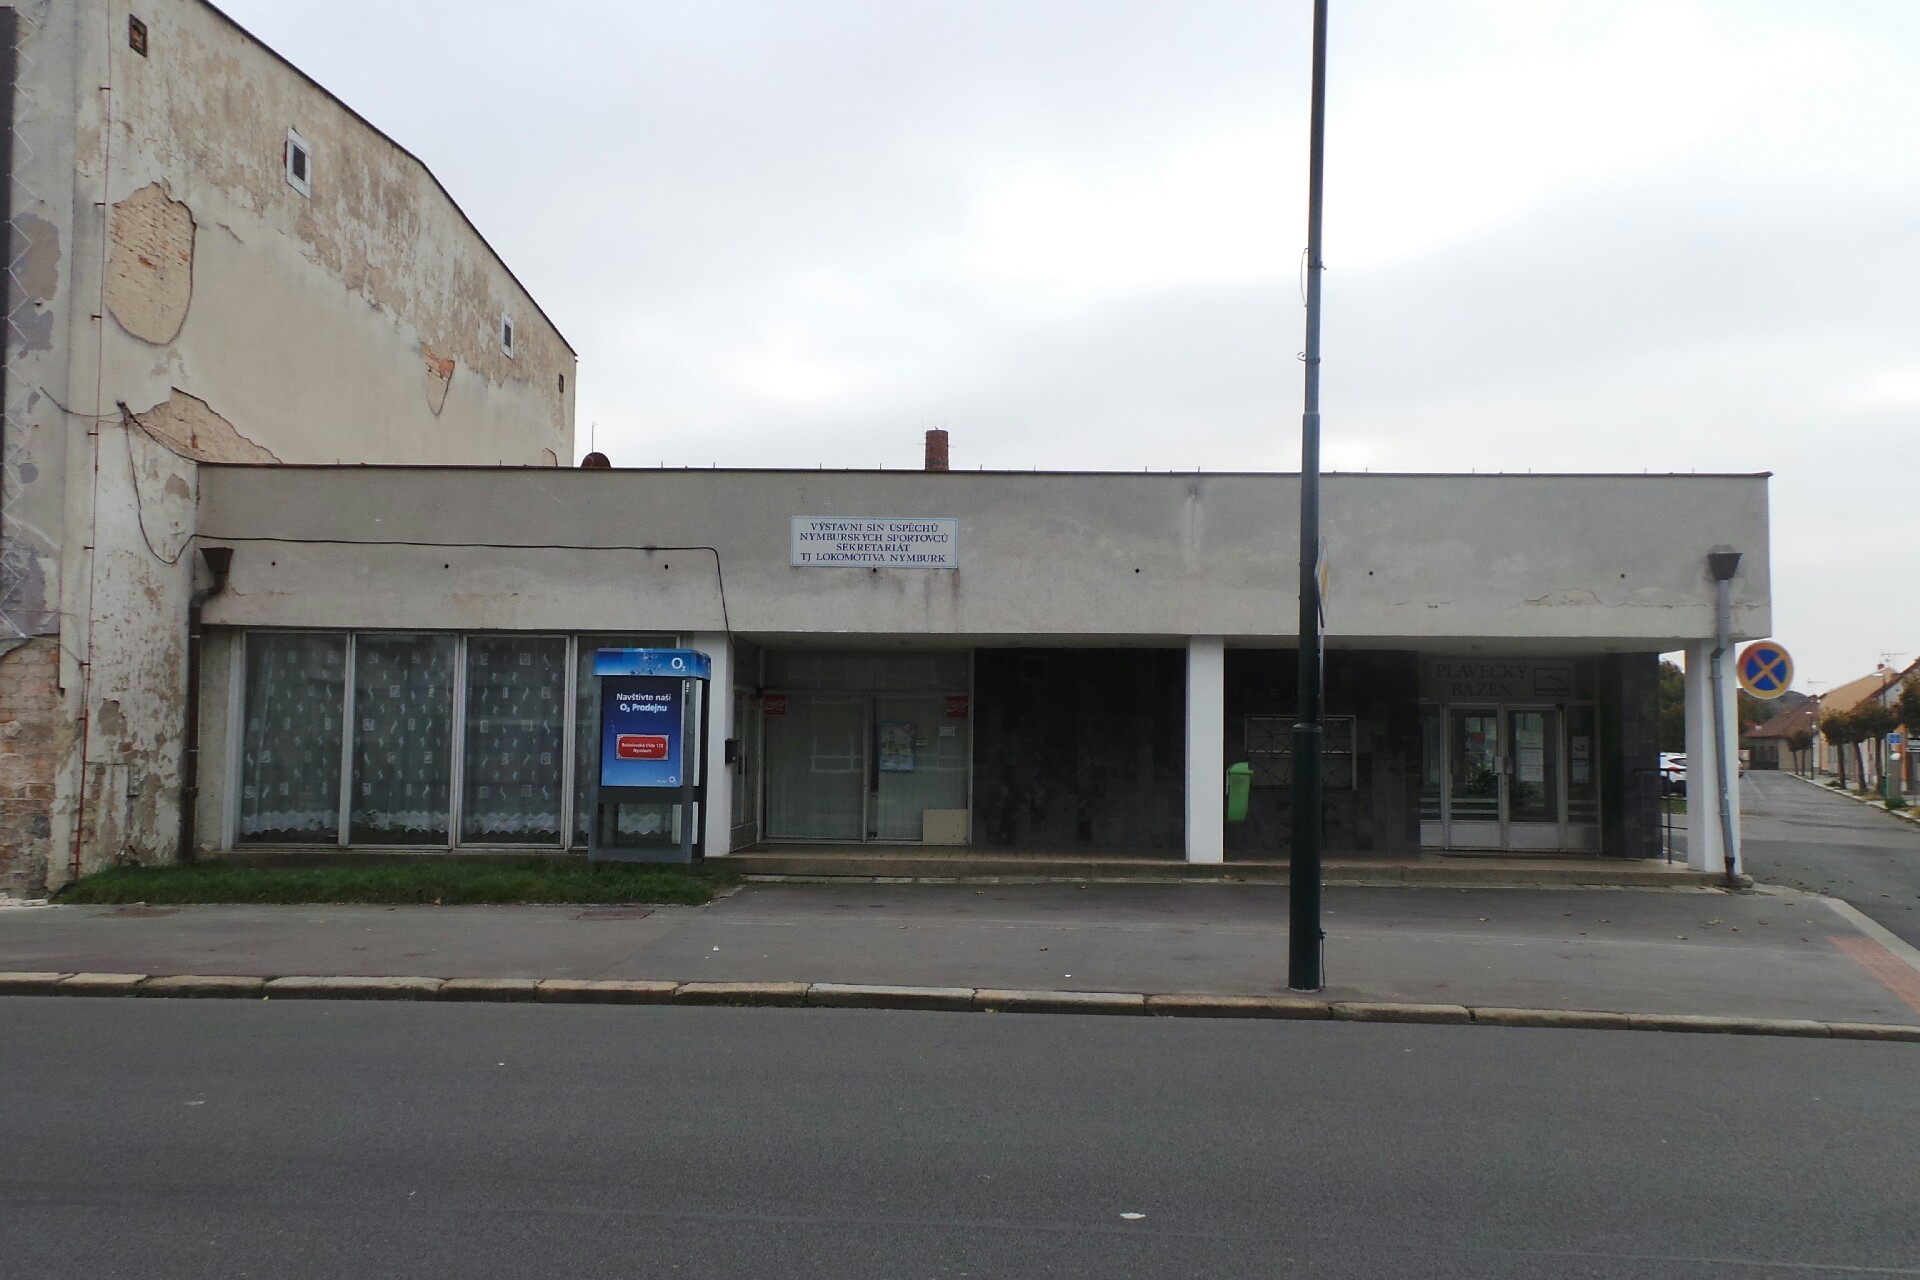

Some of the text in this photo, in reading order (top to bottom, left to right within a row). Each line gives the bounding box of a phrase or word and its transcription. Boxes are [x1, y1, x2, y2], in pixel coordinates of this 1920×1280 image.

[889, 522, 939, 533] ÚSPĚCHŮ
[799, 532, 949, 543] NYMBURSKÝCH SPORTOVCŮ
[836, 543, 910, 552] SEKRETARIÁT
[800, 552, 946, 563] TJ LOKOMOTIVA NYMBURK
[1436, 662, 1529, 679] PLAVECKÝ
[616, 692, 672, 702] Navštivte naši
[632, 703, 668, 713] Prodejnu
